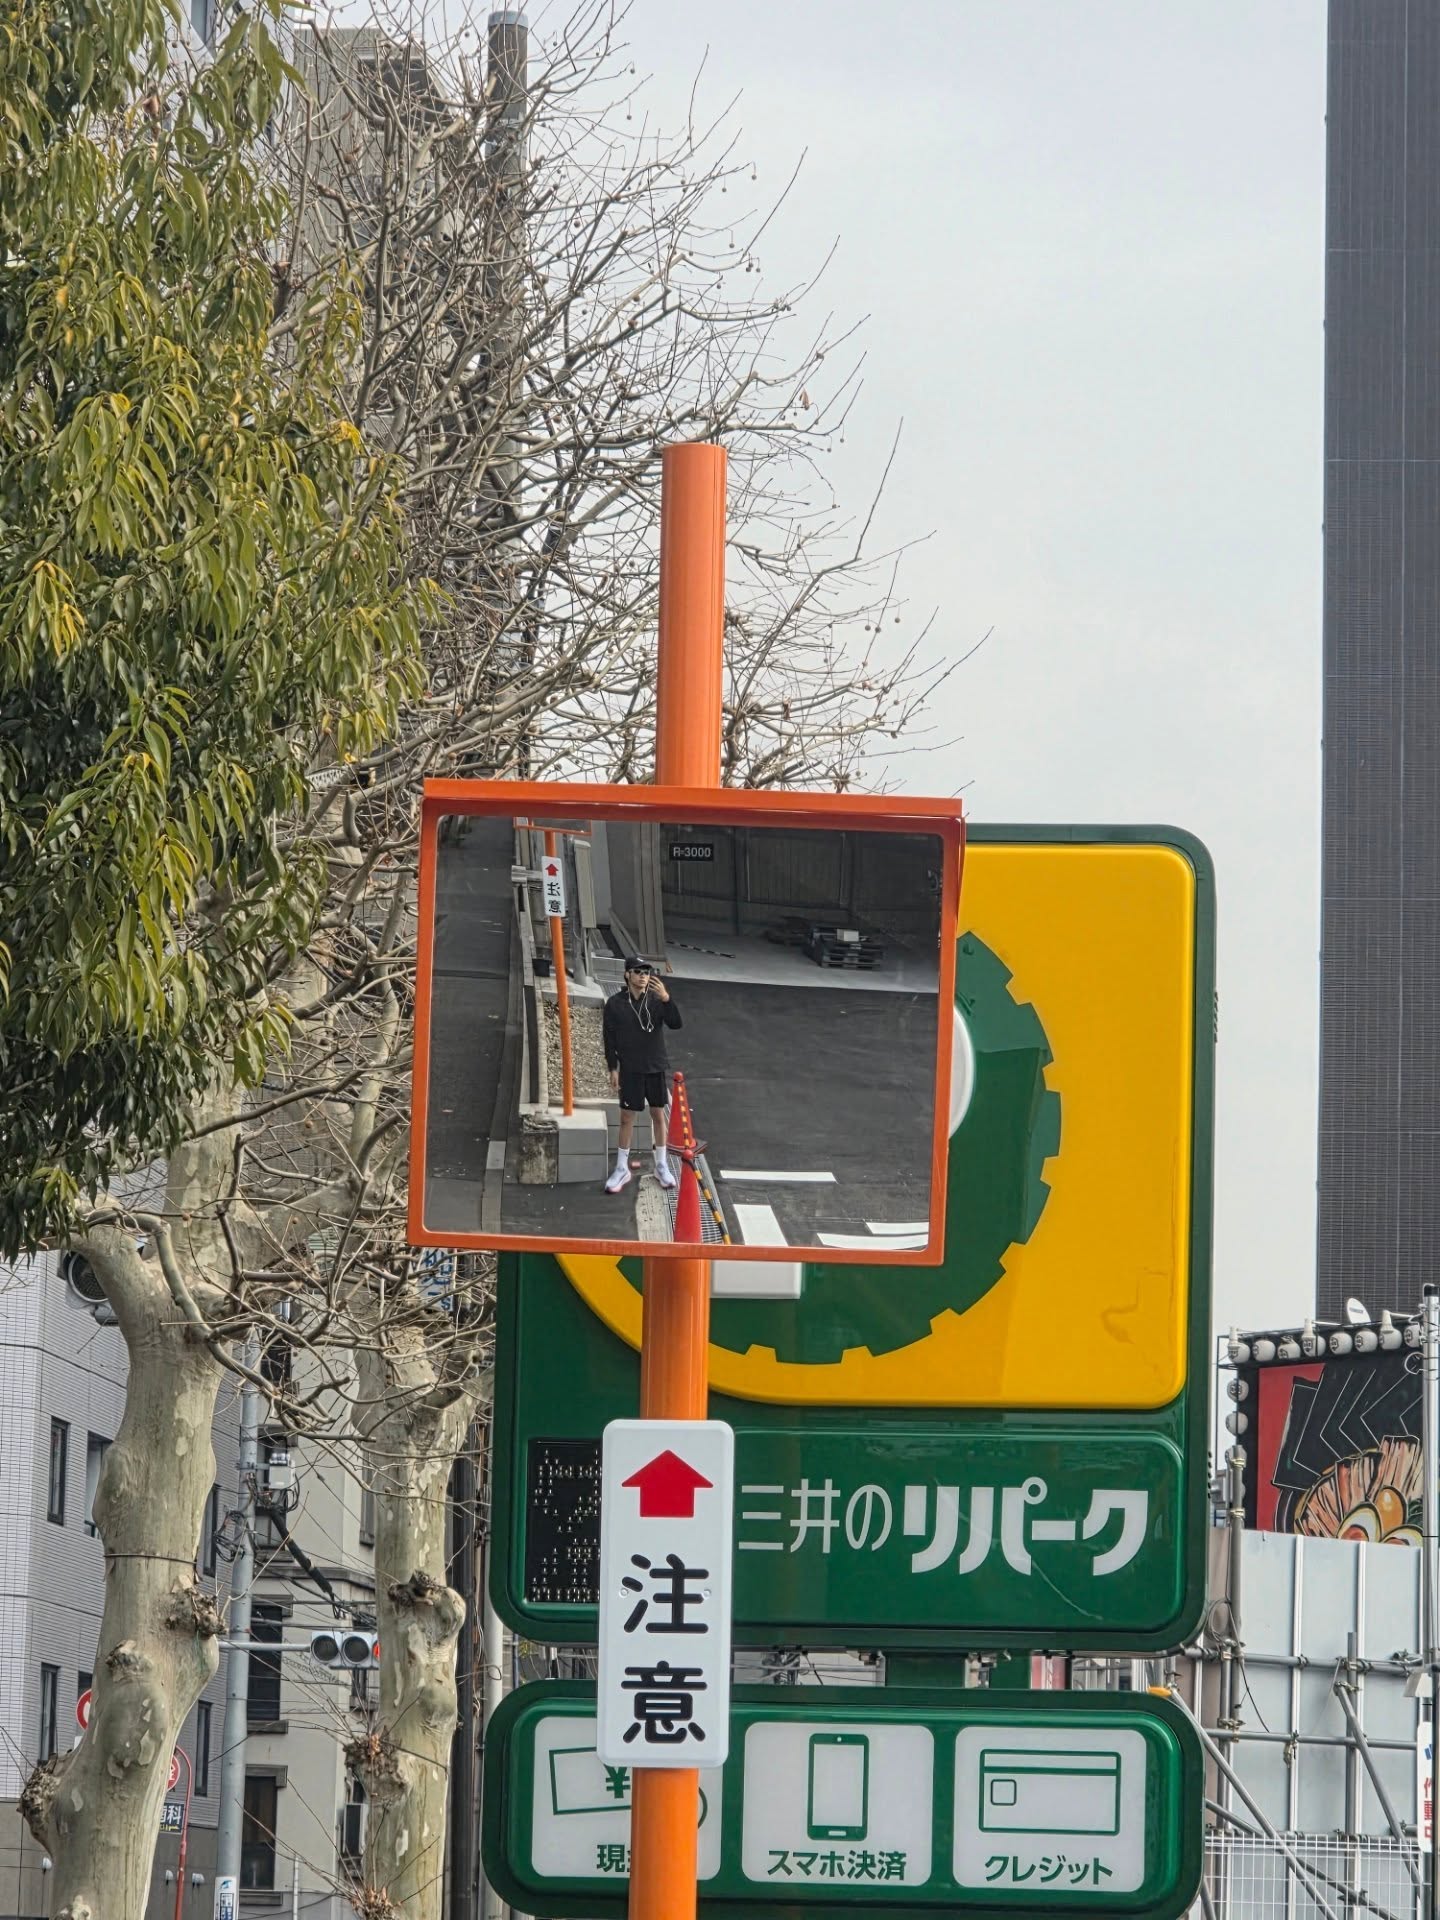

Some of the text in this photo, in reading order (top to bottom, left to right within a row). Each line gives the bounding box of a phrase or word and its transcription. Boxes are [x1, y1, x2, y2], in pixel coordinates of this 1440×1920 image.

[738, 1475, 1149, 1577] 三井のリパーク
[621, 1553, 710, 1745] 注意
[596, 1844, 632, 1873] 現
[767, 1849, 908, 1882] スマホ決済
[984, 1855, 1114, 1886] クレジット
